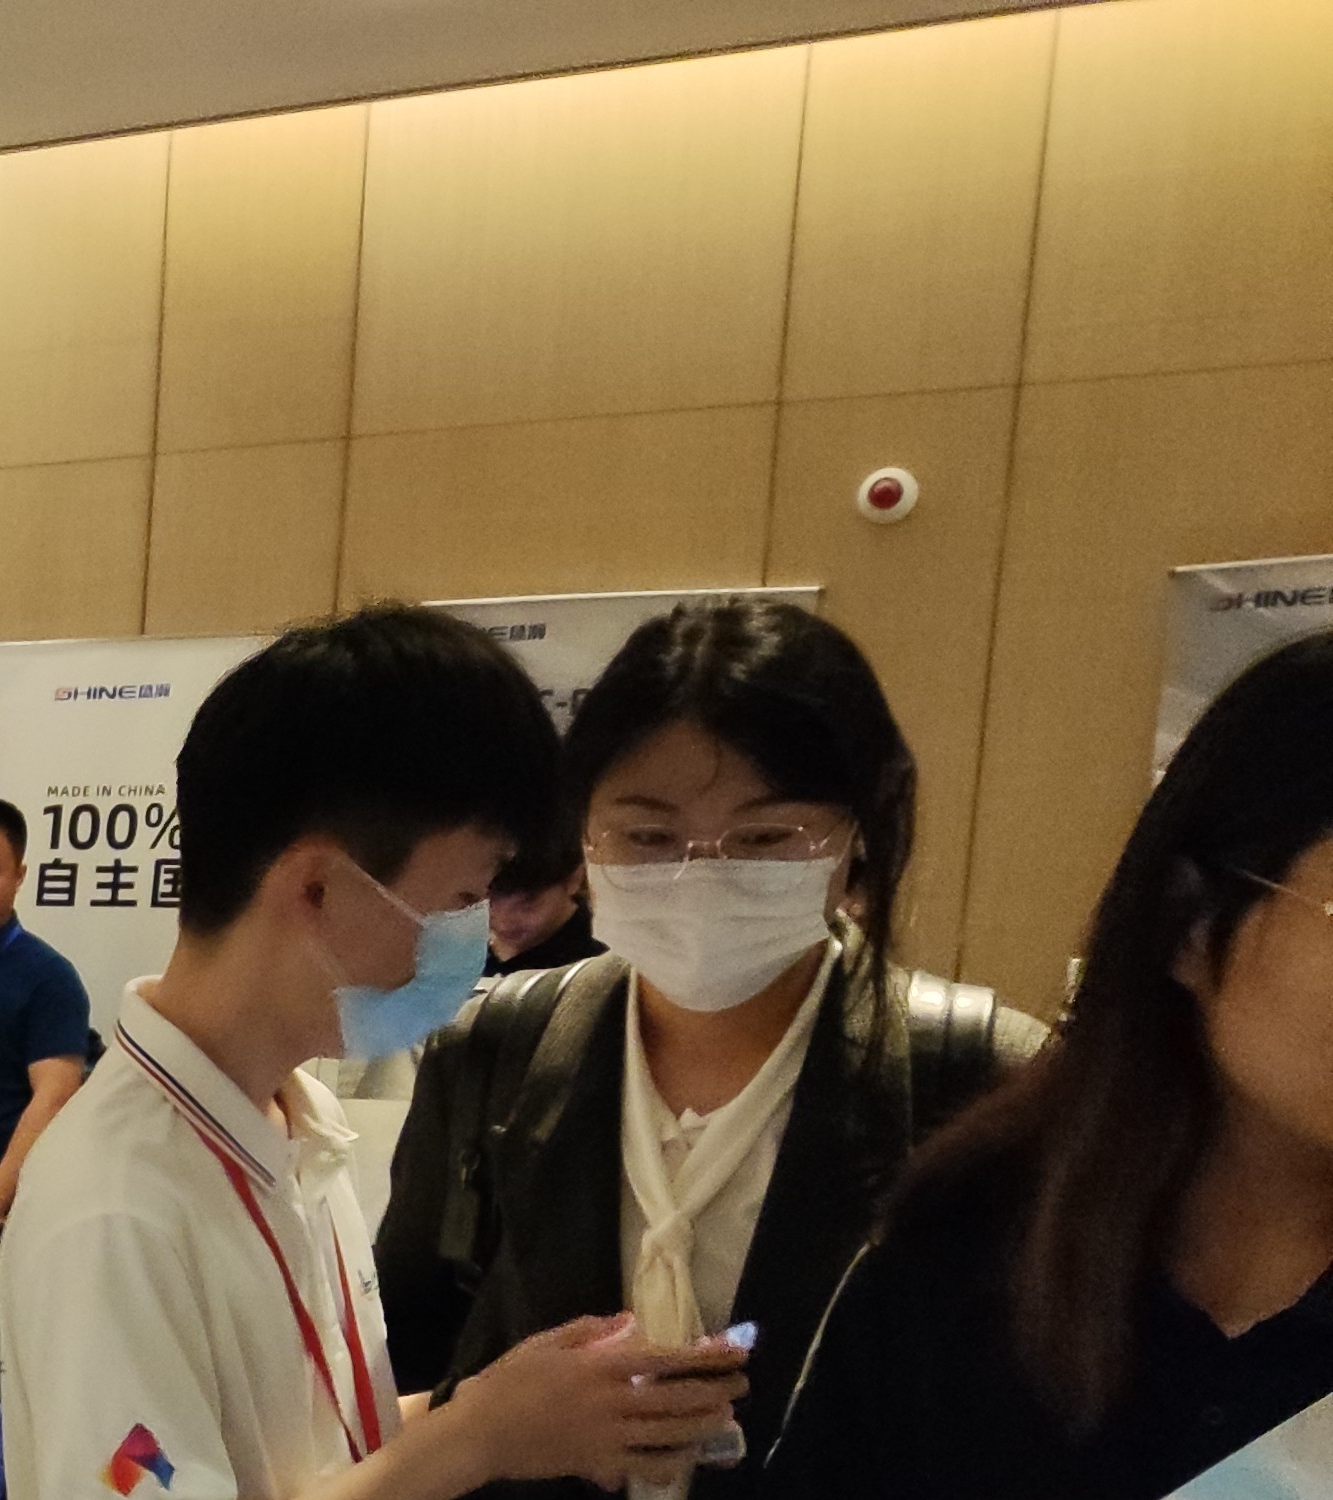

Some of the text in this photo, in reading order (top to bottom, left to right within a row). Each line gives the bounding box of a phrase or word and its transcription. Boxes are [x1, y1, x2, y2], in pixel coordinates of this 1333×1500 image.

[47, 784, 166, 797] MADE IN CHINA
[42, 803, 181, 850] 100%
